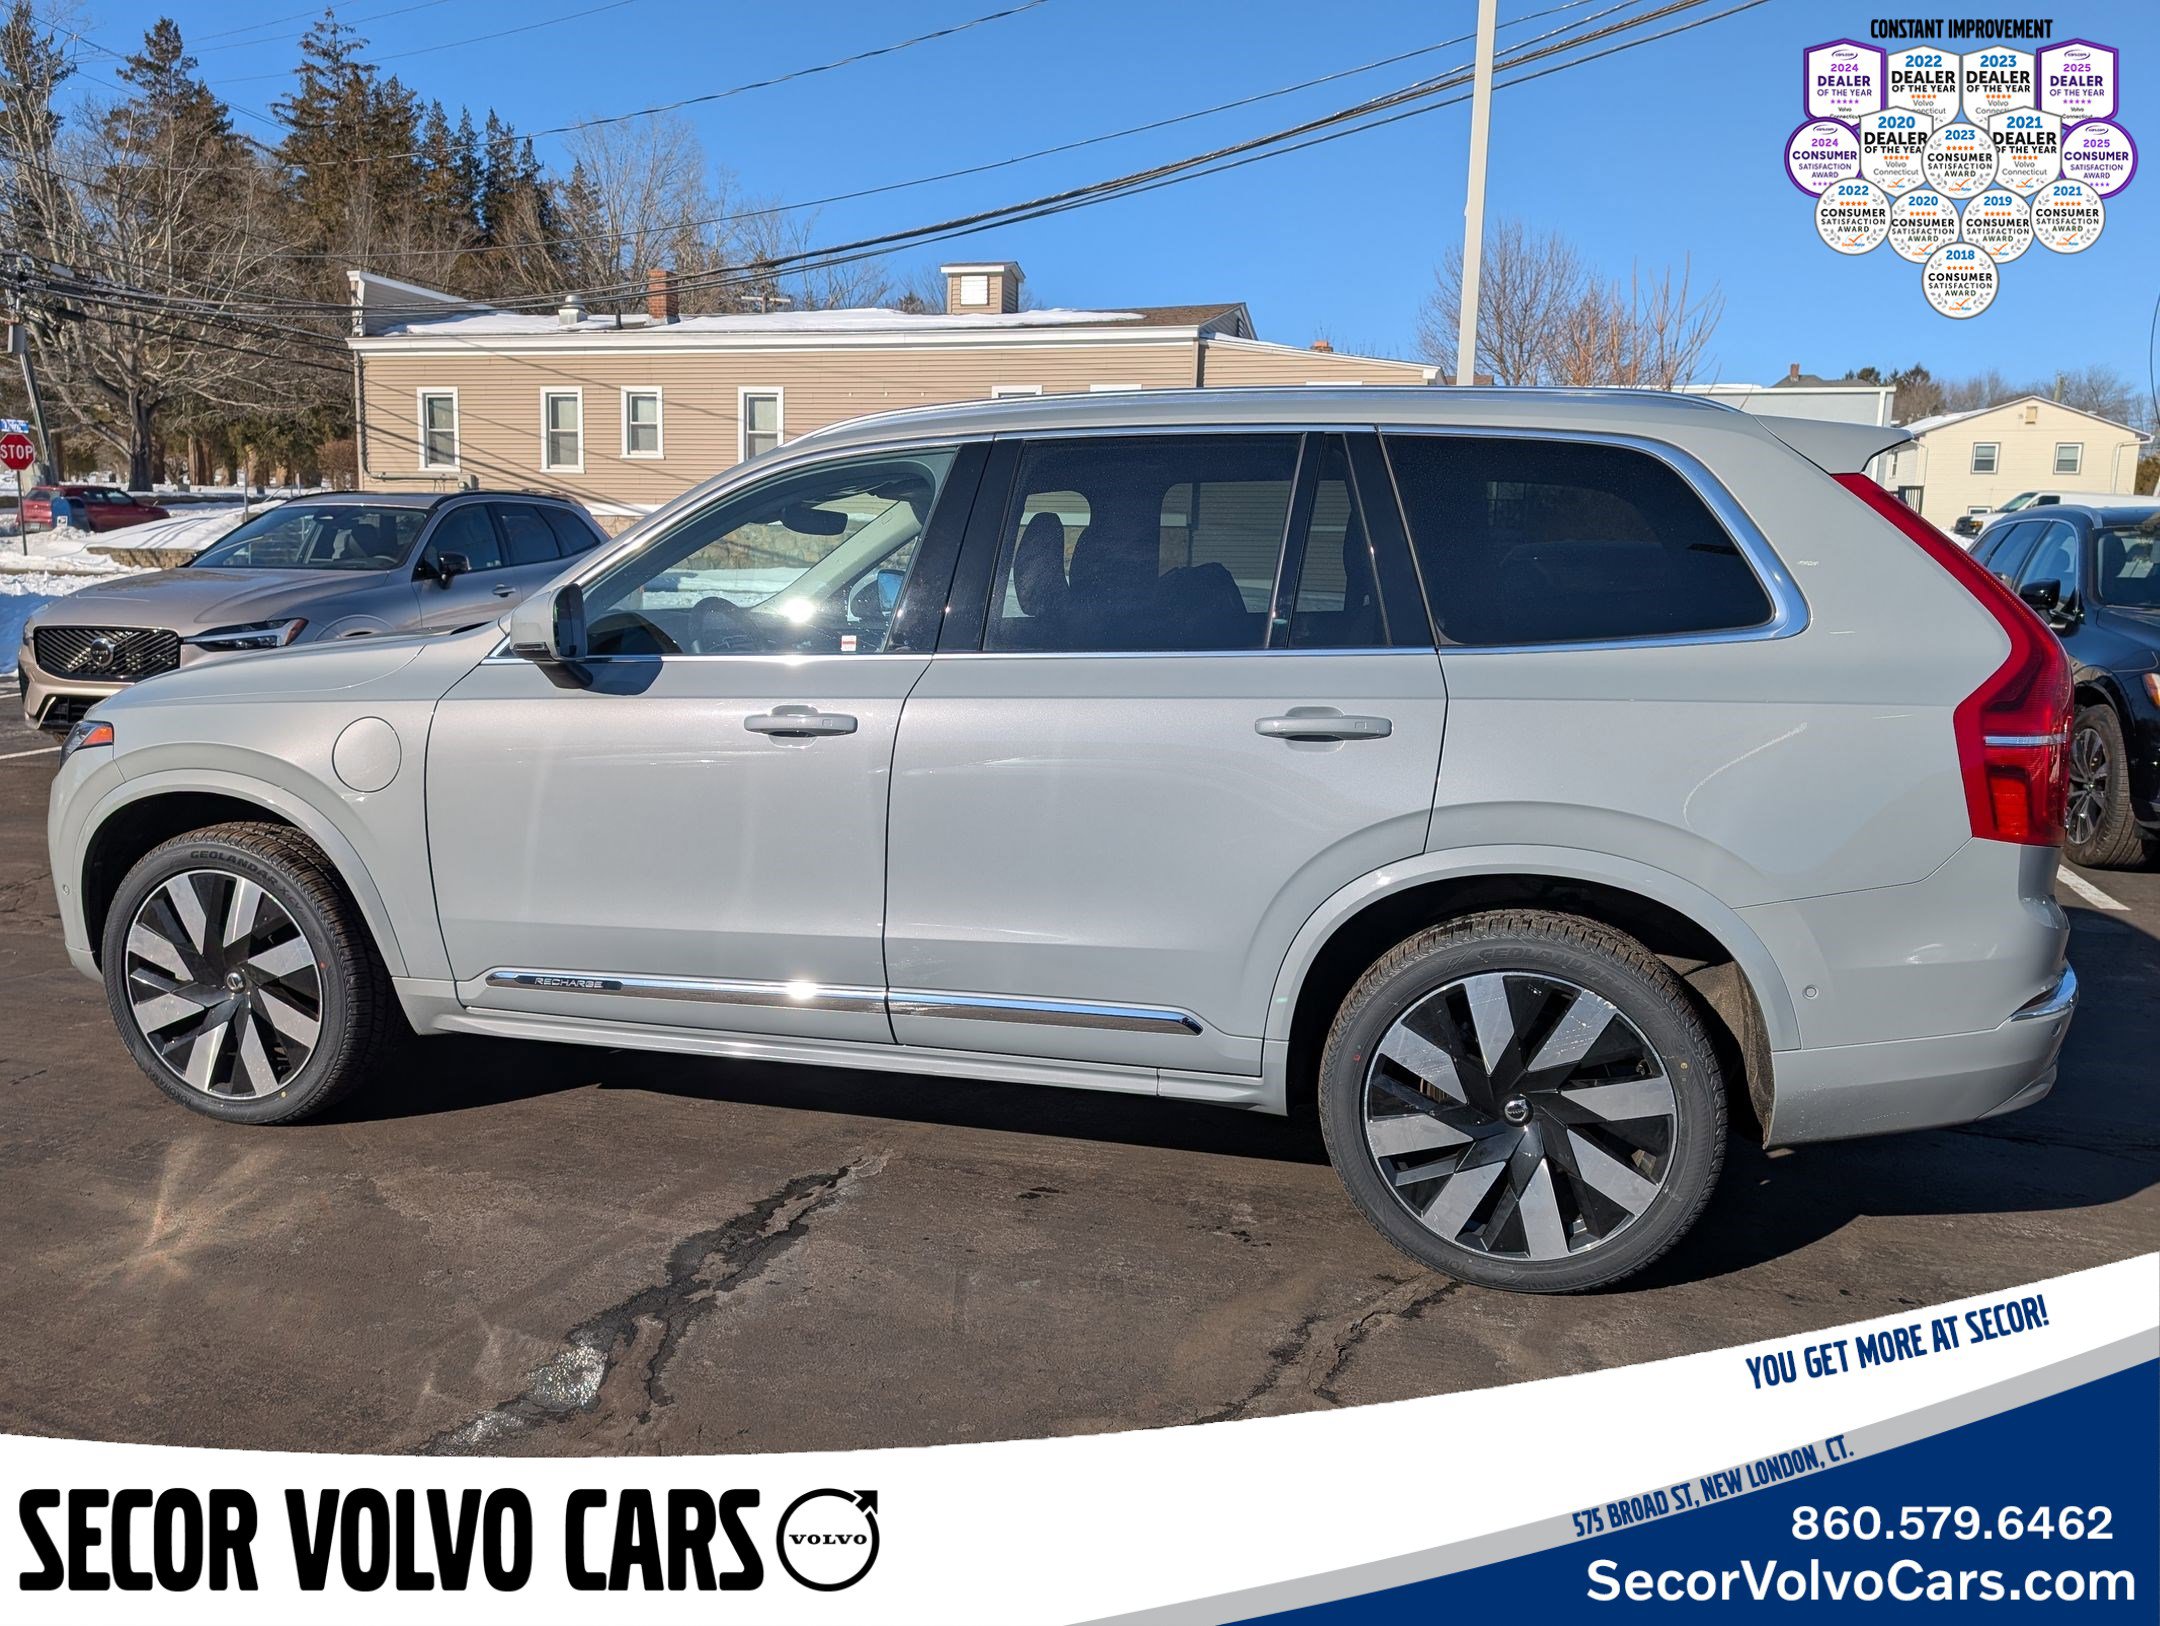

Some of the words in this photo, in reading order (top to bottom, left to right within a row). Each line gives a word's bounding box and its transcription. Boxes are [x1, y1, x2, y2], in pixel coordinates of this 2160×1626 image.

[0, 444, 33, 460] STOP
[190, 850, 278, 886] GEOLANDAR
[534, 977, 604, 989] RECHARGE
